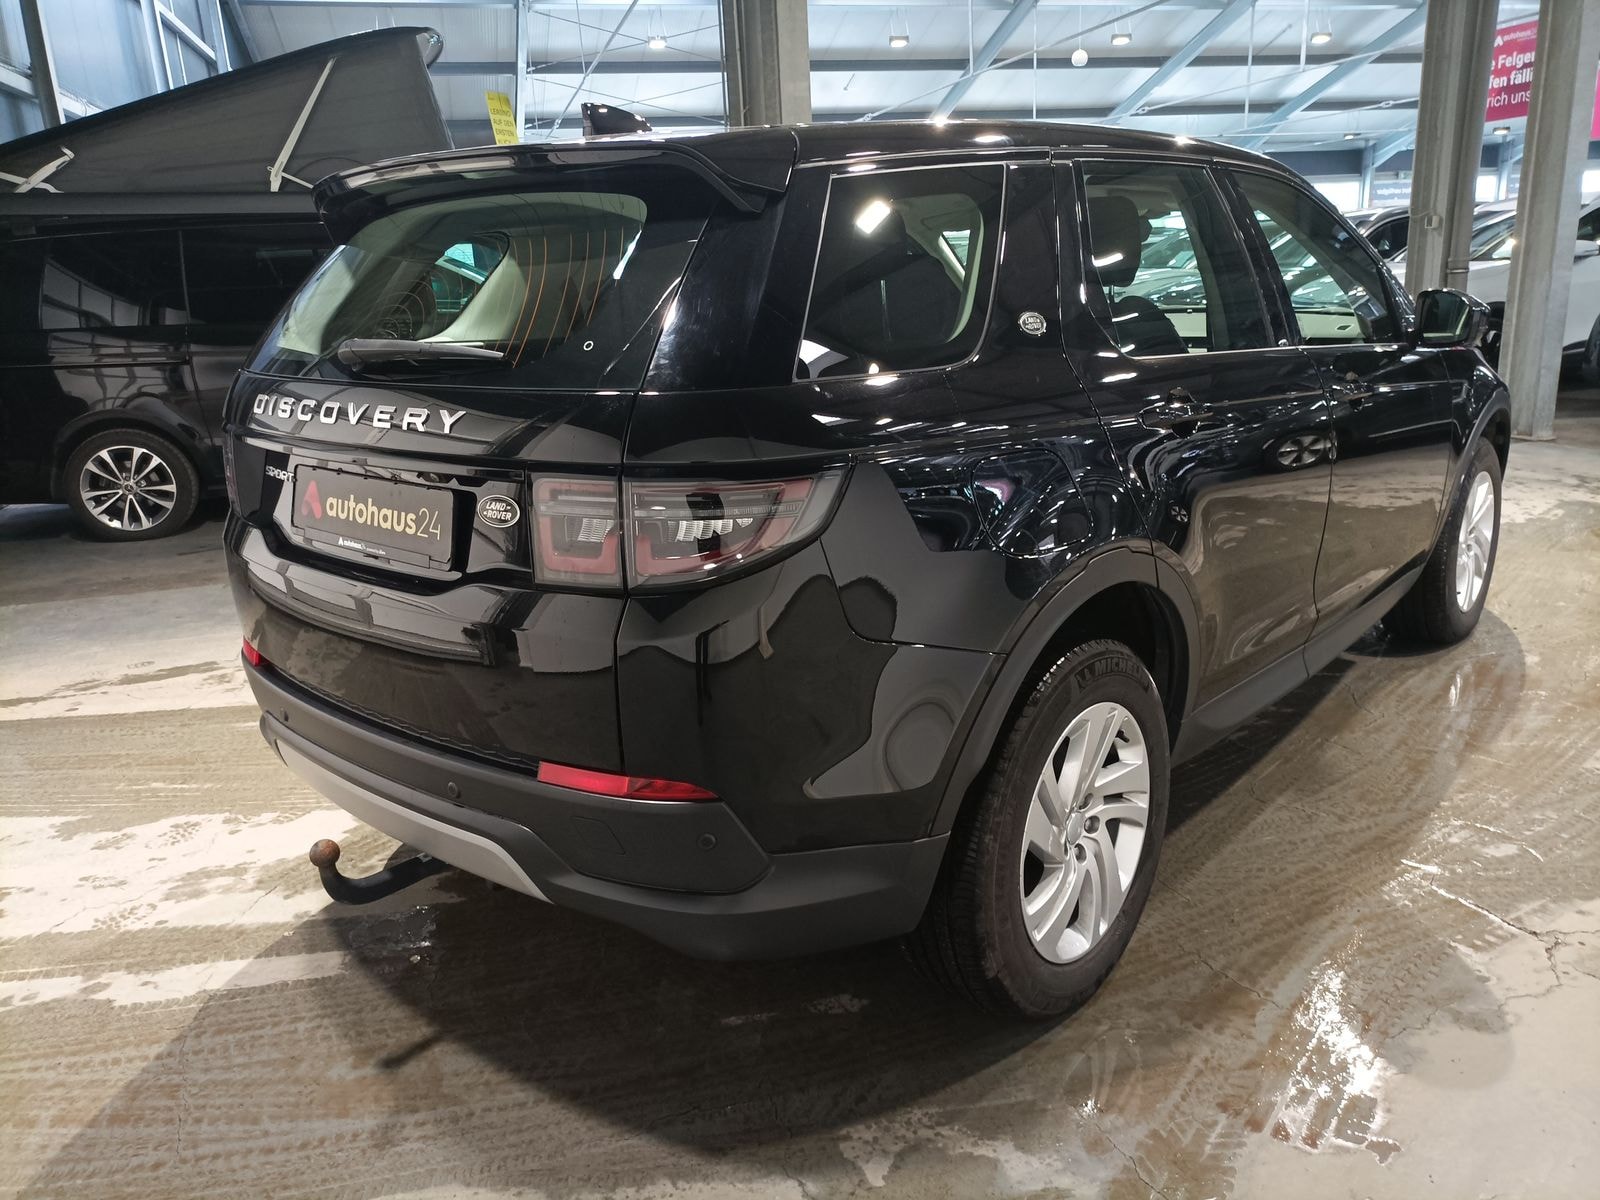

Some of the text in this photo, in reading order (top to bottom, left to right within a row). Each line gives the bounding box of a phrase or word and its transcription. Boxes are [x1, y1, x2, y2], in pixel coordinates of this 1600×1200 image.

[253, 393, 467, 434] DISCOVERY
[265, 465, 294, 482] SPORT
[486, 501, 506, 511] LAND
[326, 494, 441, 541] autohaus24
[486, 510, 512, 521] ROVER
